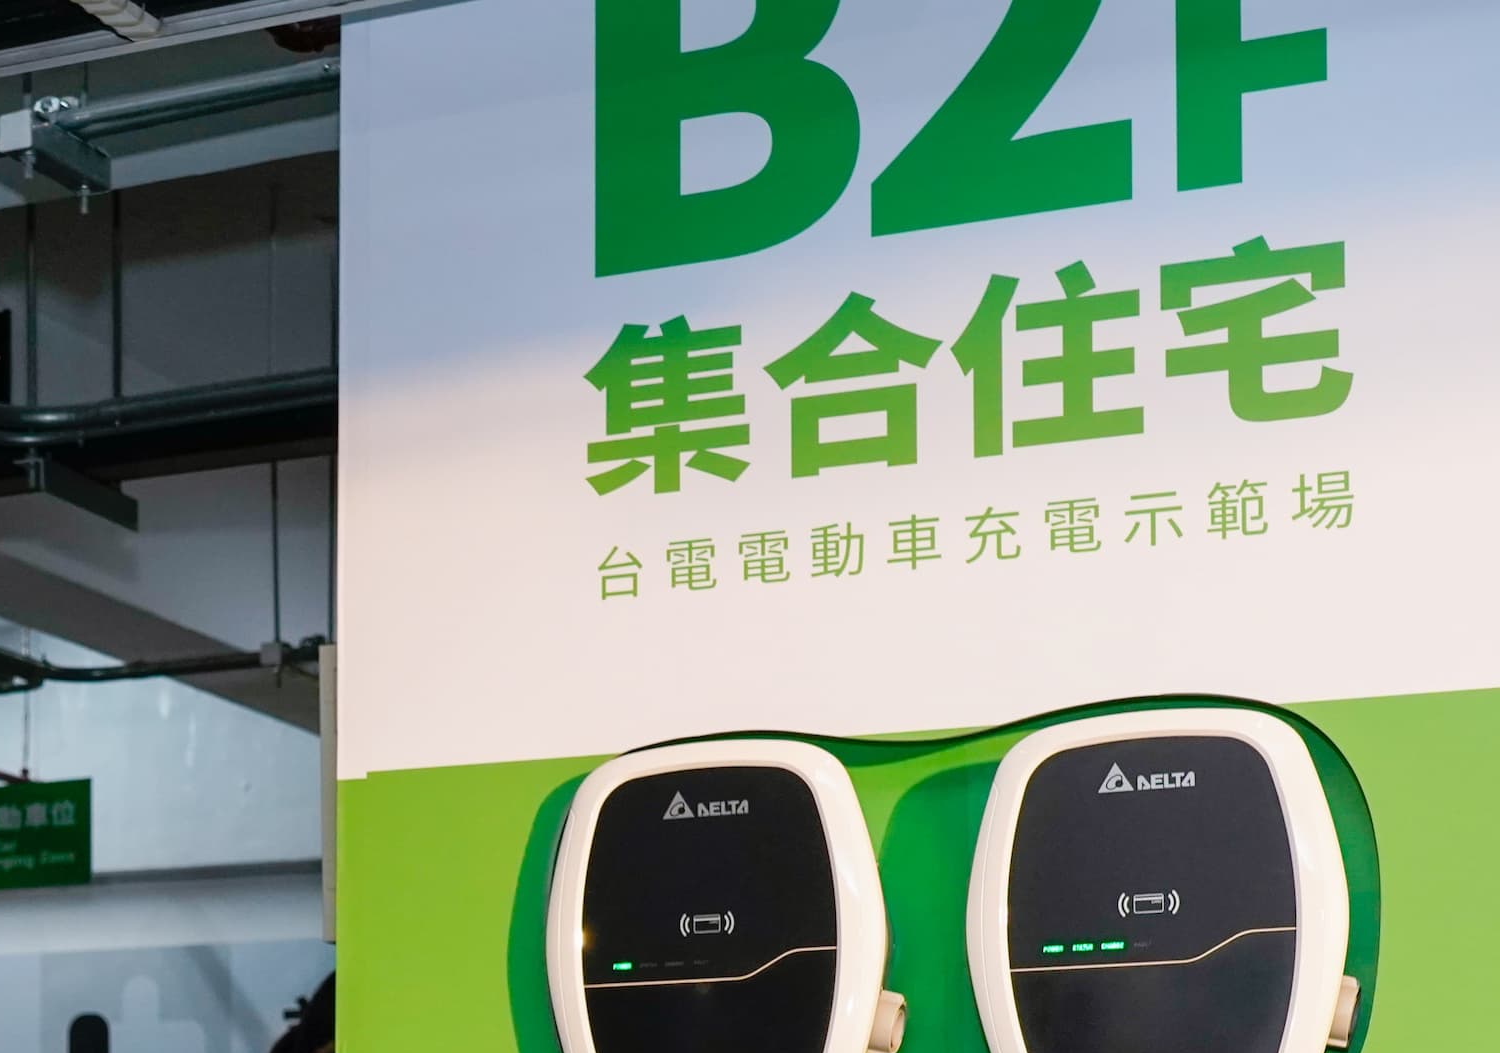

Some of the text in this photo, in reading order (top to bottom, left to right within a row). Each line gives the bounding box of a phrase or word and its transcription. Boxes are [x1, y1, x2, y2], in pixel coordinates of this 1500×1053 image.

[583, 234, 1355, 497] 集合住宅
[596, 470, 1355, 600] 台電電動車充電示範場
[697, 799, 749, 818] DELTA
[1137, 770, 1195, 791] DELTA
